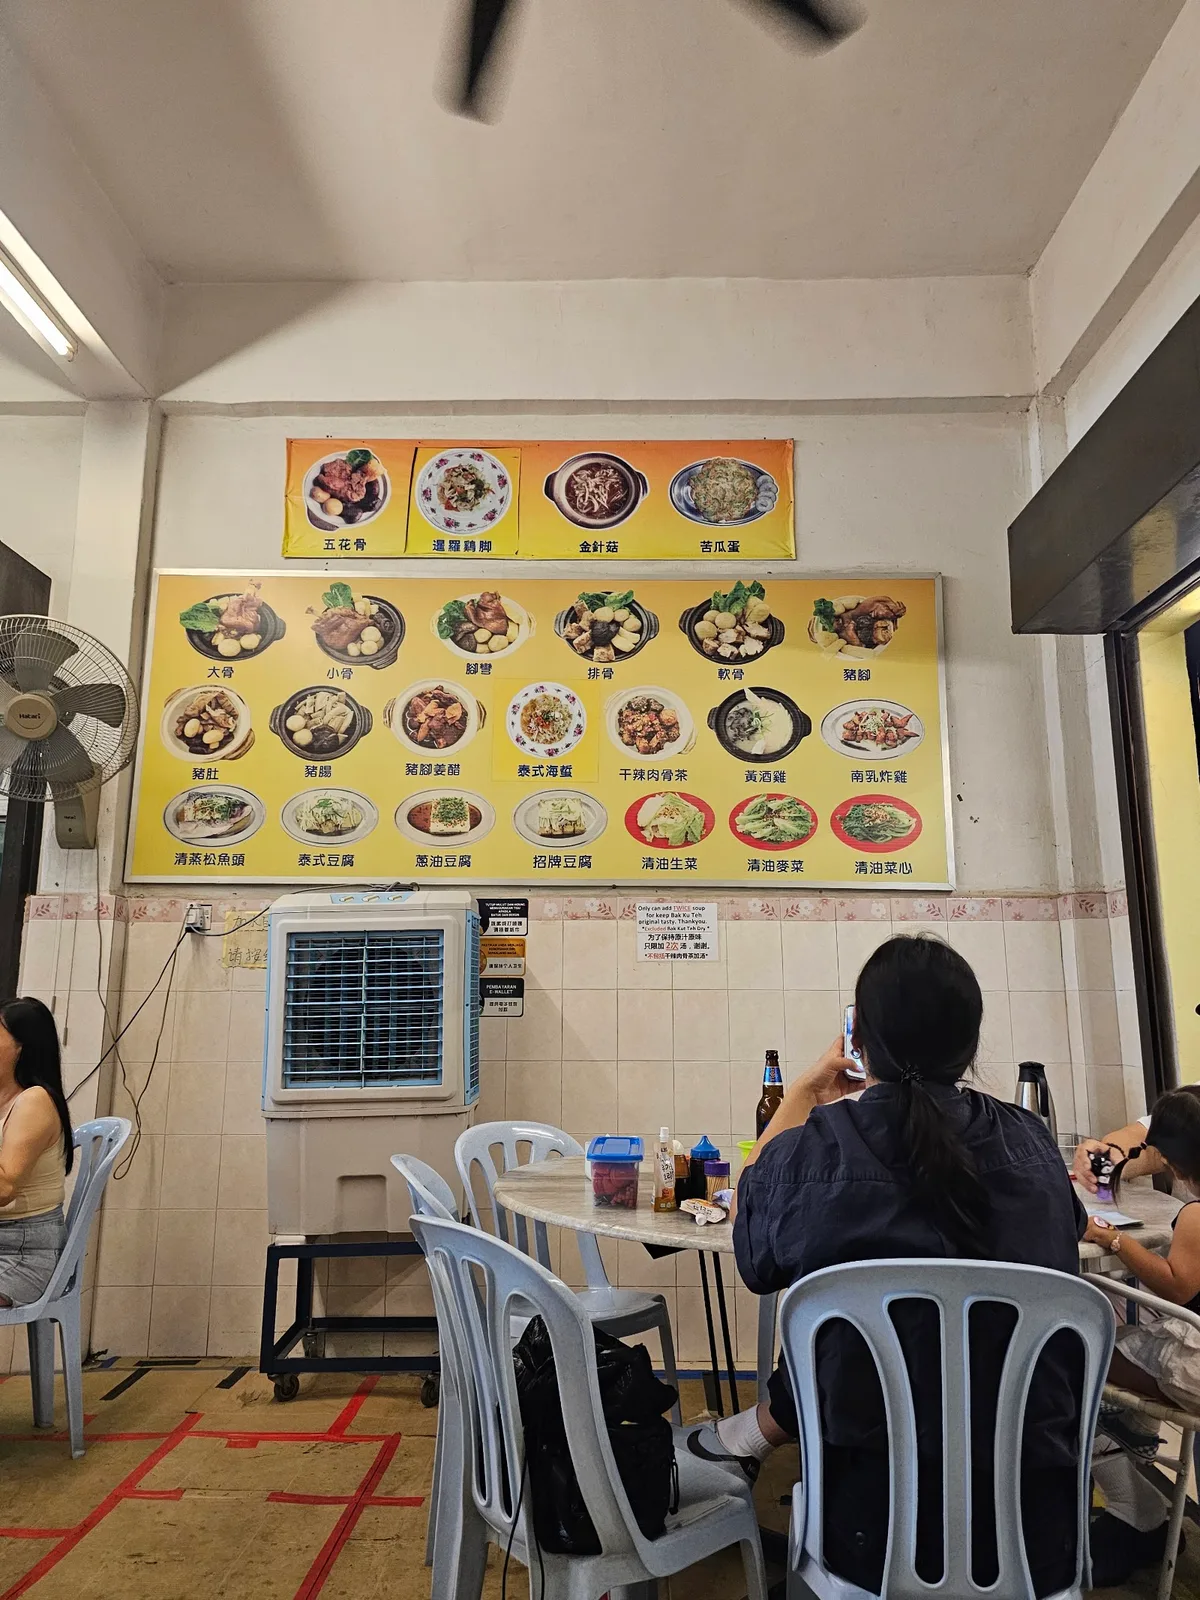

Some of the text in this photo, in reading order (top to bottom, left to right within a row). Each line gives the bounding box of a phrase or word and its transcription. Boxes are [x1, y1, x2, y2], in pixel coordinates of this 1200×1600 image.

[323, 539, 366, 551] 五花骨
[579, 541, 618, 553] 金針菇
[700, 541, 740, 554] 苦瓜蛋
[208, 667, 234, 678] 大骨
[327, 668, 353, 680] 小骨
[588, 667, 614, 680] 排骨
[718, 669, 744, 680] 軟骨
[844, 669, 870, 681] 豬腳
[192, 768, 219, 780] 豬肚
[305, 766, 331, 777] 豬腸
[619, 769, 687, 781] 干辣肉骨茶
[851, 770, 907, 783] 南乳炸雞
[174, 853, 245, 866] 清蒸松魚頭
[298, 854, 354, 867] 泰式豆腐
[533, 855, 592, 868] 招牌豆腐
[642, 857, 697, 870] 清油生菜
[748, 859, 803, 872] 清油麥菜
[855, 861, 912, 874] 清油菜心
